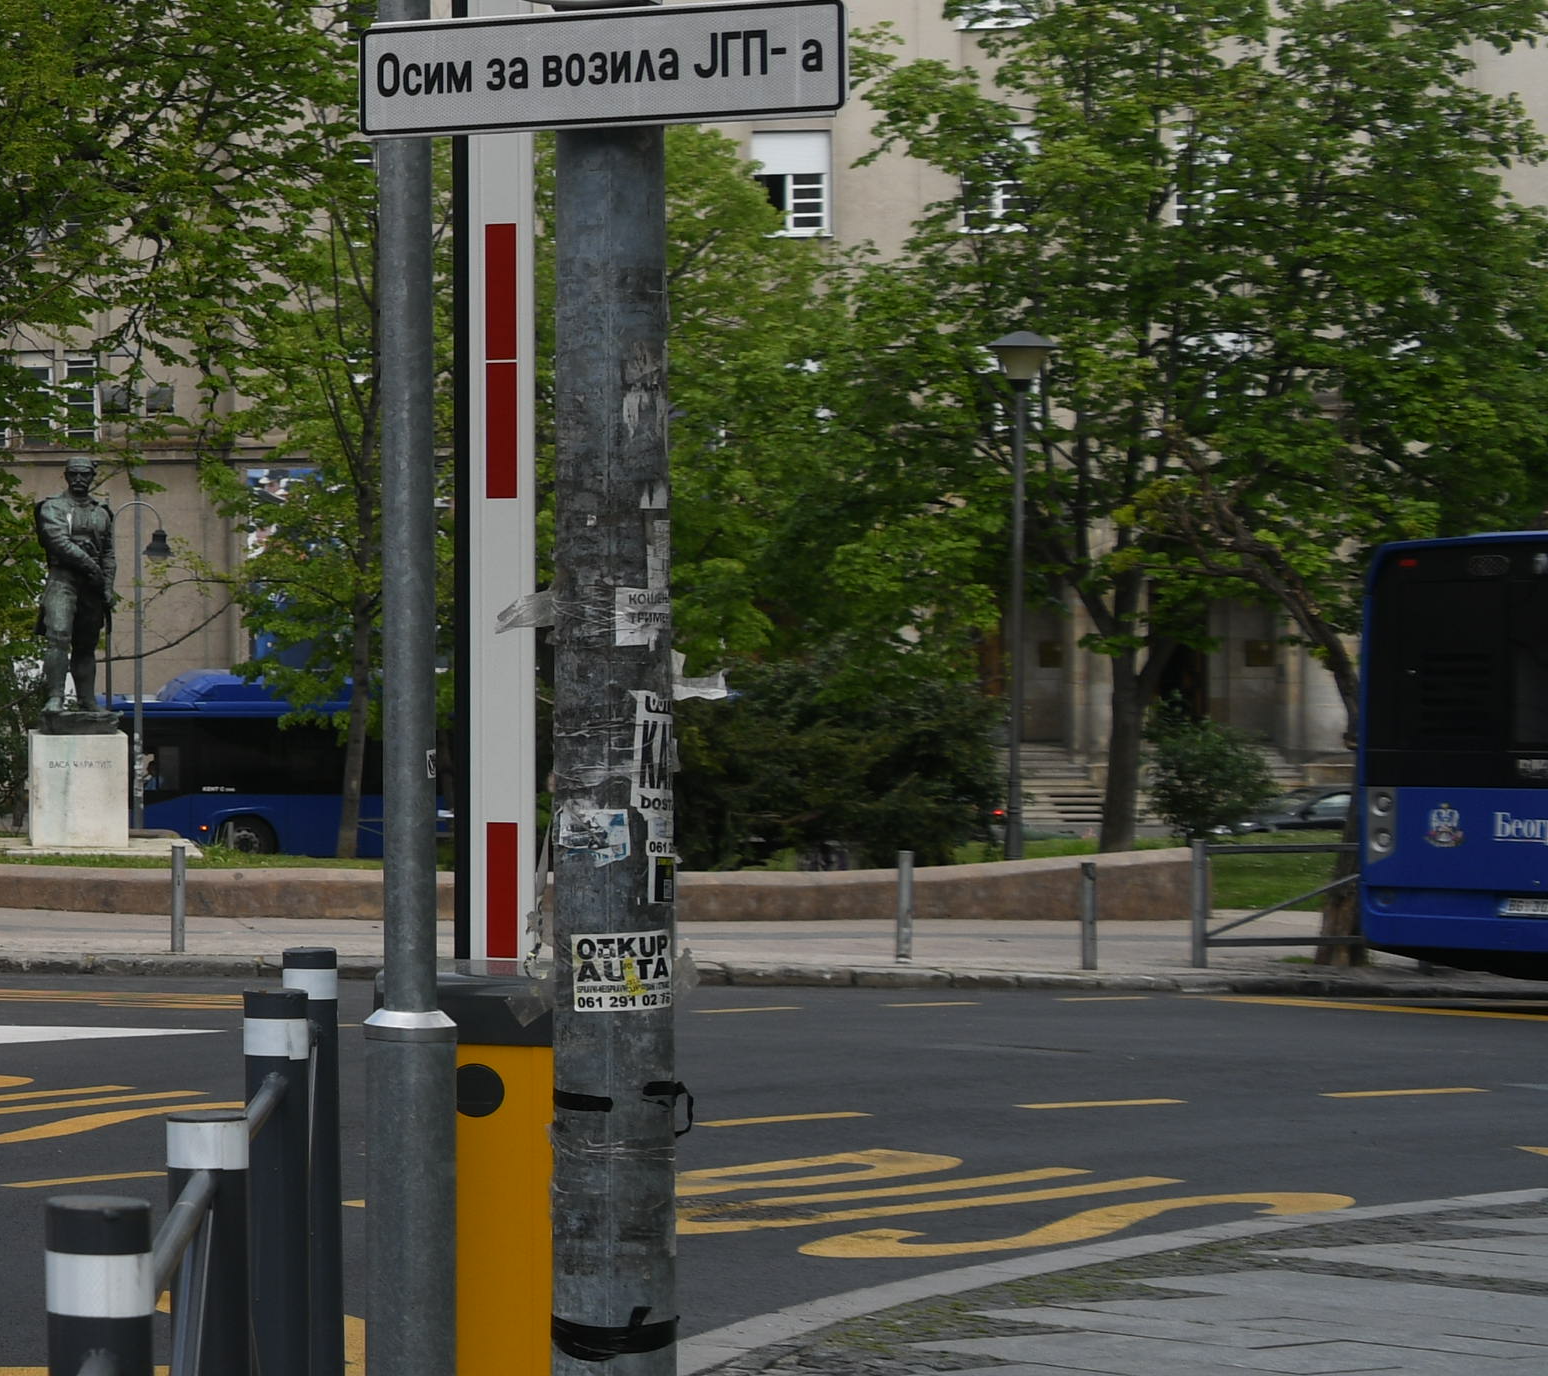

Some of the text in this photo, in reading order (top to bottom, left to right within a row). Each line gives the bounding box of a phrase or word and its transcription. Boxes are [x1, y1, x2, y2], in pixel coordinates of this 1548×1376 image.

[376, 51, 472, 98] Осим
[486, 56, 528, 91] за
[543, 47, 680, 88] возила
[577, 935, 668, 960] OTKUP
[577, 957, 669, 982] AUTA
[577, 996, 603, 1008] 061
[609, 995, 637, 1008] 291
[642, 994, 658, 1006] 02
